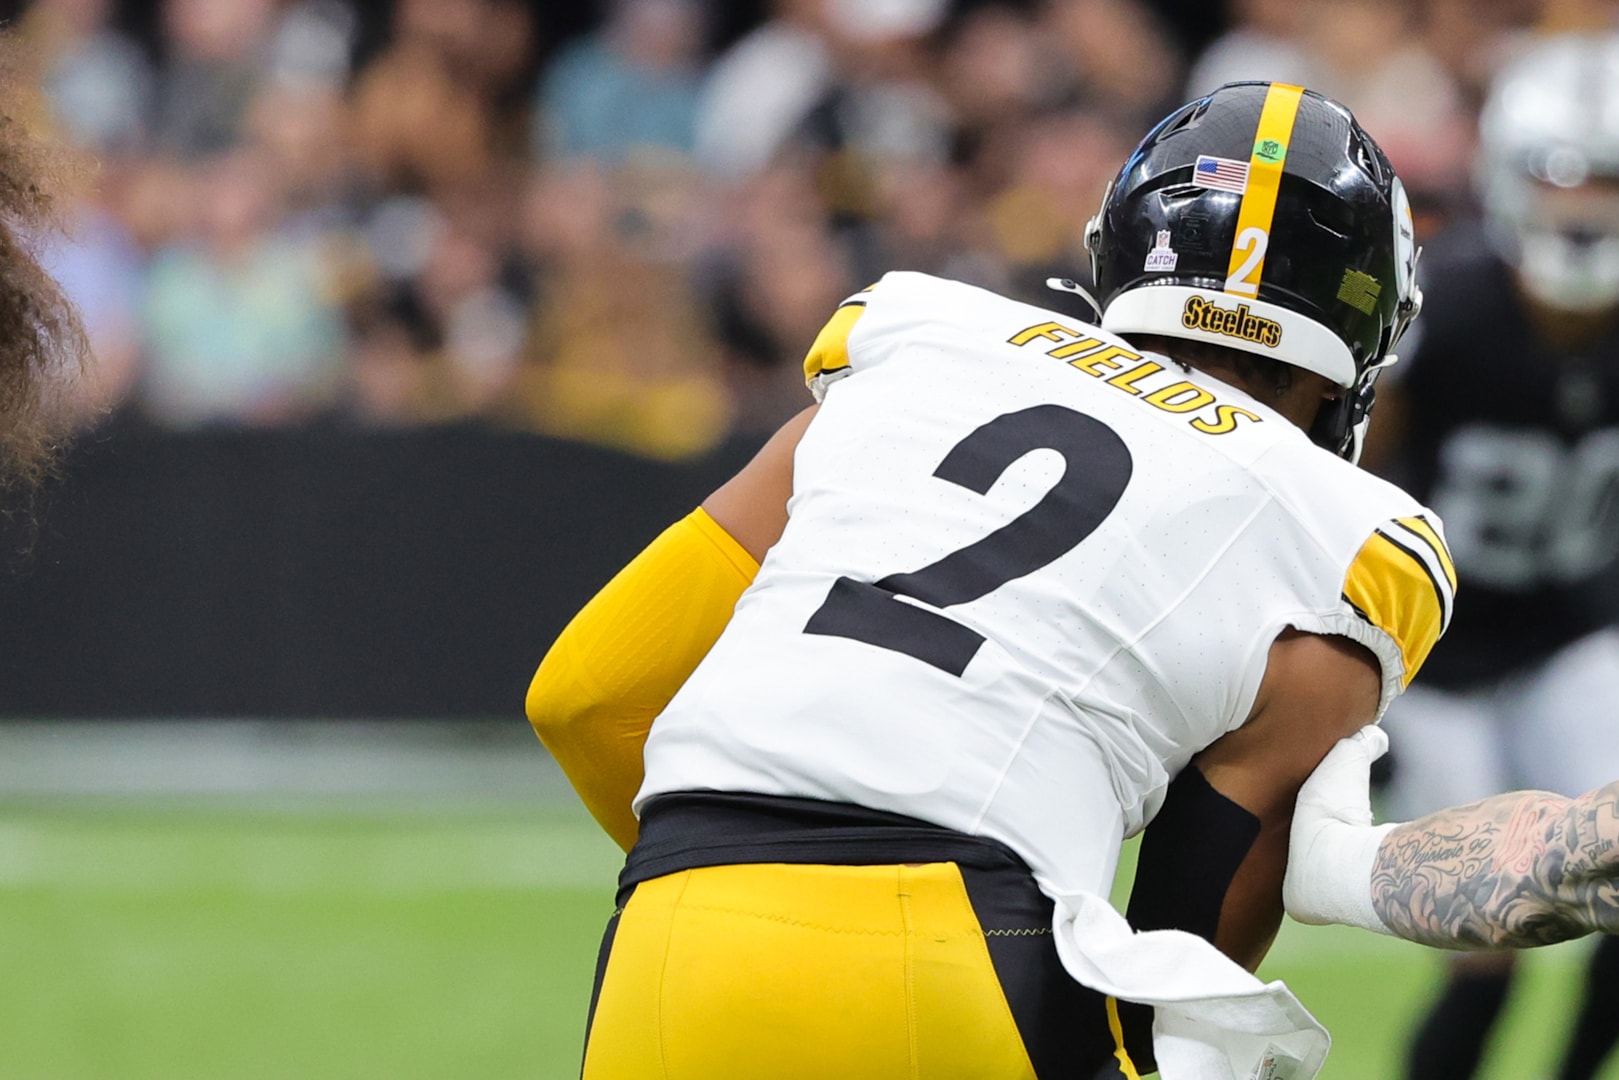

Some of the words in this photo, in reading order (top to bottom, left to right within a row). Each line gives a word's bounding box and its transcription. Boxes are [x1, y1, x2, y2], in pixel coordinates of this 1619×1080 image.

[1147, 255, 1176, 266] CATCH
[1224, 227, 1269, 294] 2
[1182, 295, 1283, 348] Steelers
[1006, 321, 1264, 435] FIELDS
[803, 403, 1134, 678] 2
